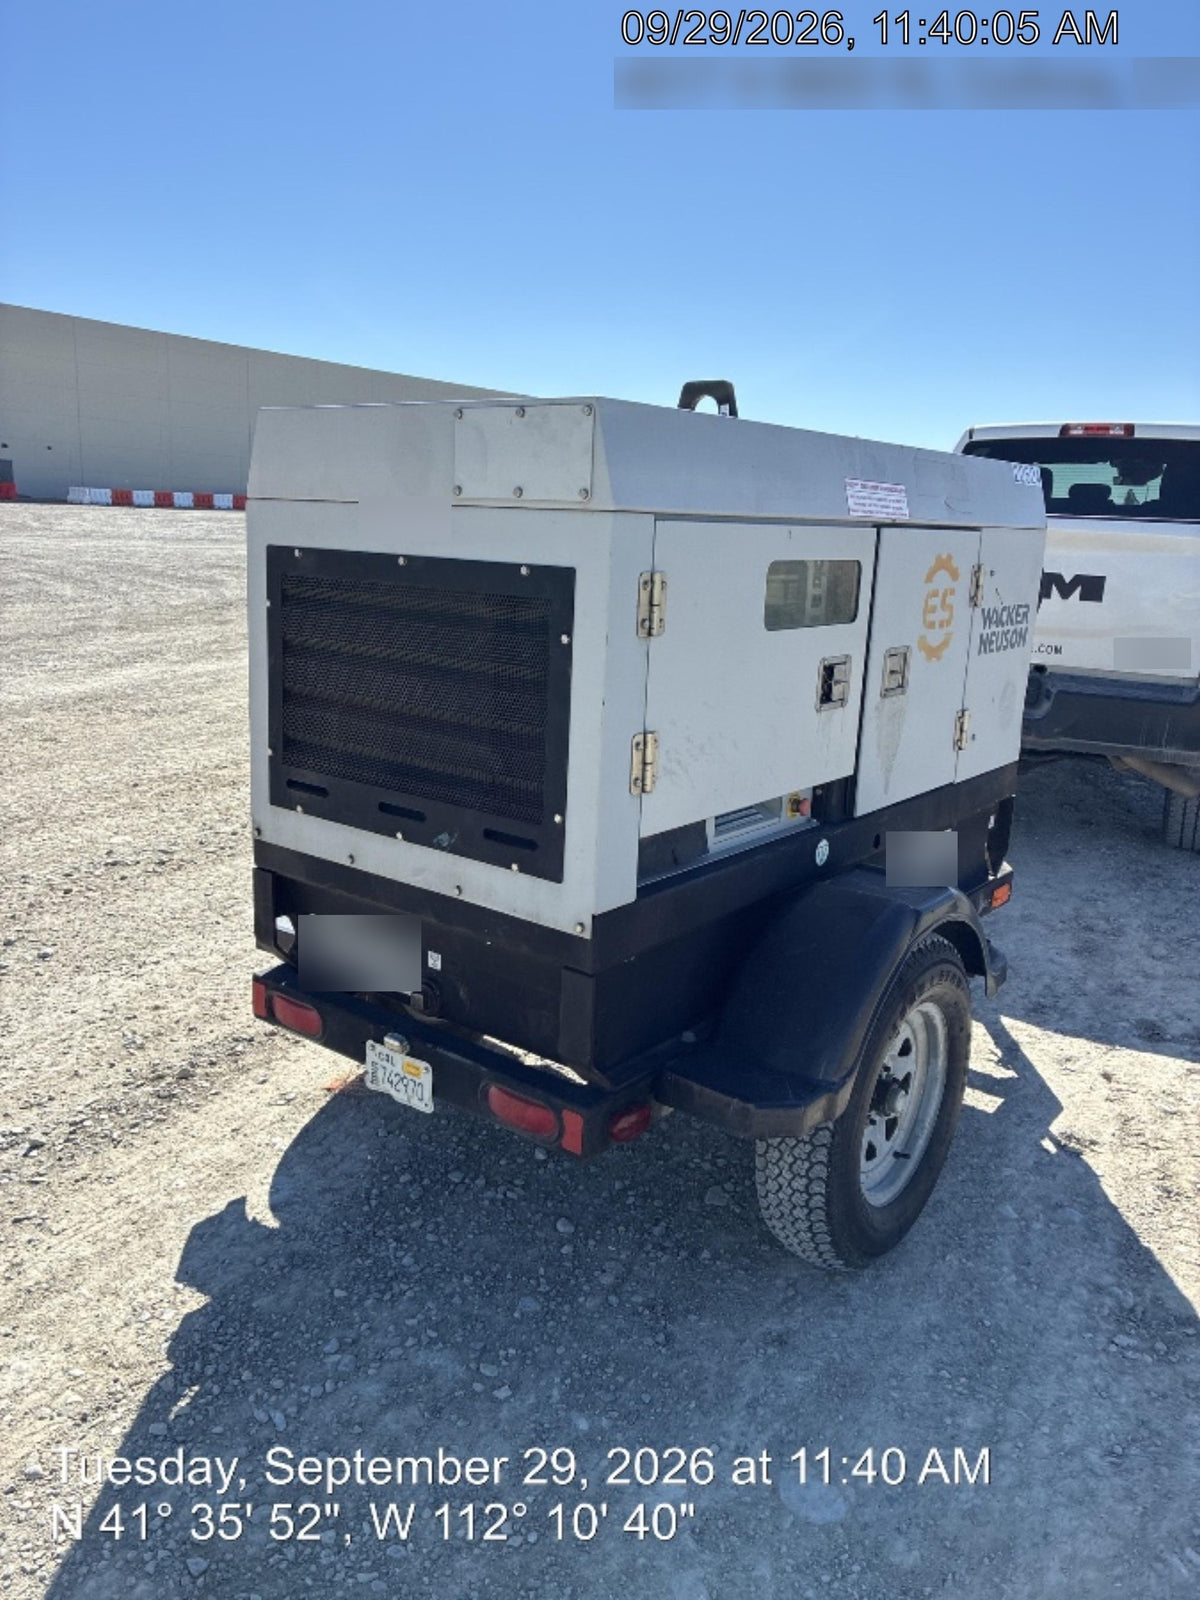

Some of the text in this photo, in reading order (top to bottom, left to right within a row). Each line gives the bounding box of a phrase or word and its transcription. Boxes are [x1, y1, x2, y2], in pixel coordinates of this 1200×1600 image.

[981, 603, 1031, 630] WACKER
[977, 627, 1028, 656] NEUSON
[1031, 643, 1062, 655] .COM
